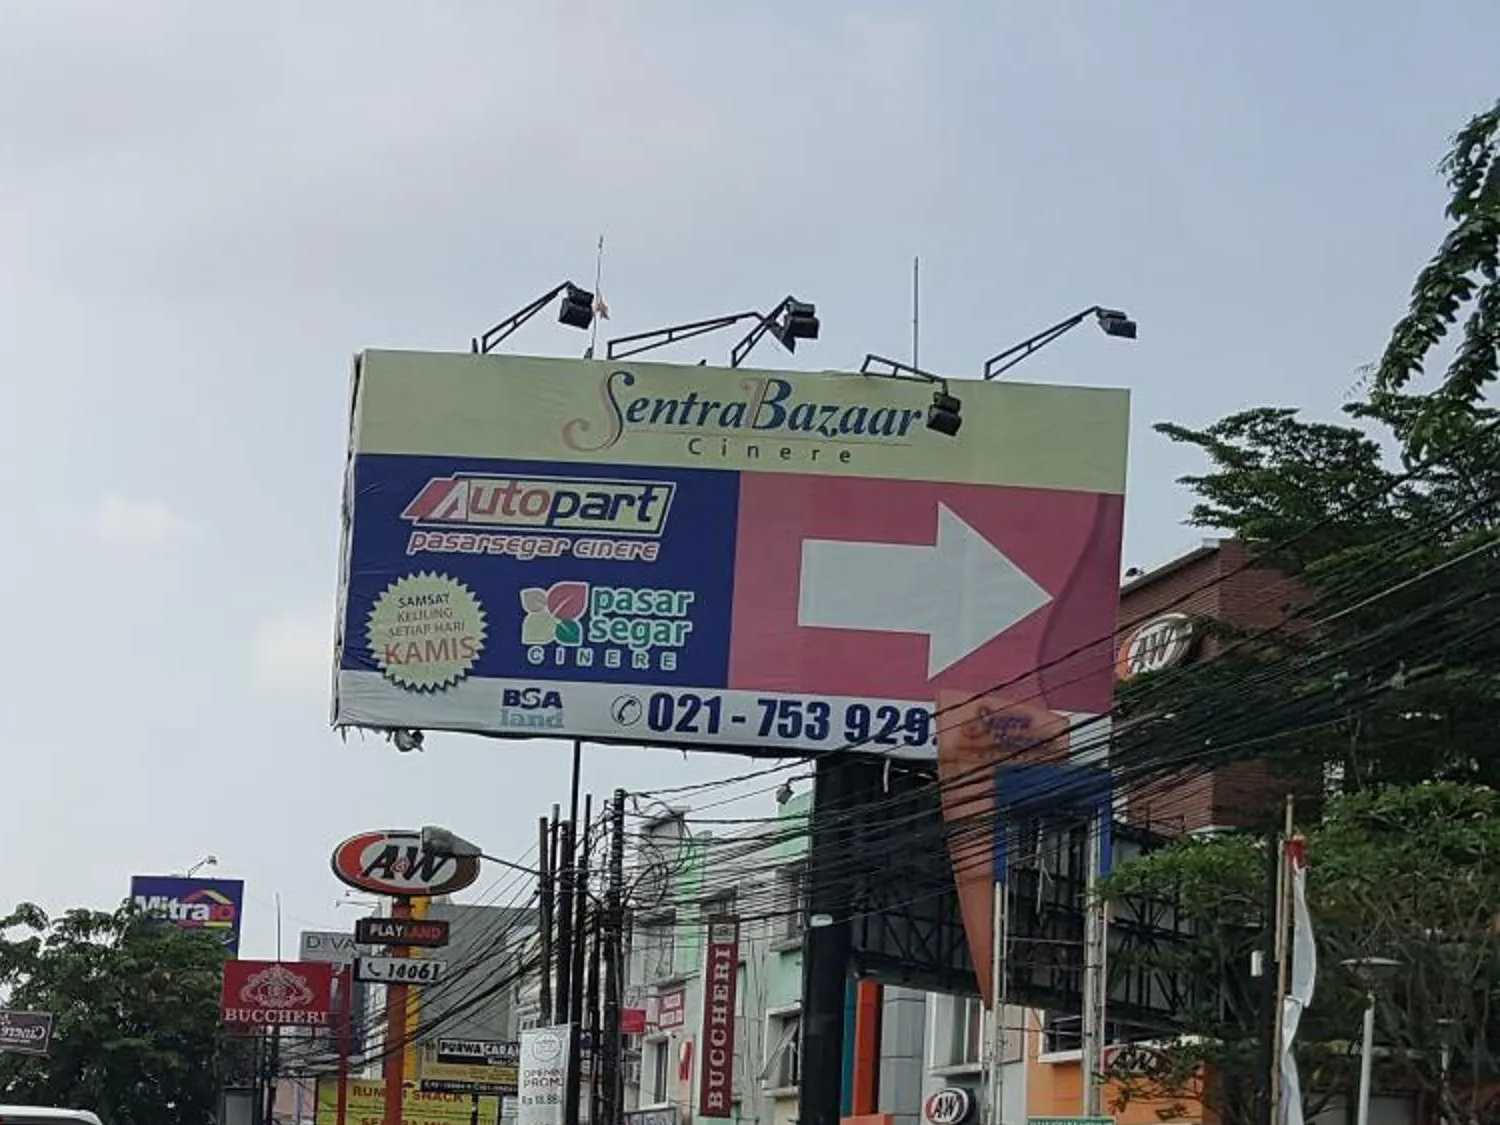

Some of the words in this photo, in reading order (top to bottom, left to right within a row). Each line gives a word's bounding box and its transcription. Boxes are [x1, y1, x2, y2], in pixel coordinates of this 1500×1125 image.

[688, 437, 852, 464] Cinere
[574, 539, 660, 561] cinere
[398, 593, 451, 609] SAMSAT
[591, 586, 695, 617] pasar
[388, 623, 431, 638] SETIAP
[434, 620, 465, 635] HARI
[589, 617, 693, 649] segar
[384, 635, 477, 666] KAMIS
[527, 646, 678, 670] CINERE
[502, 687, 563, 710] BSA
[501, 709, 565, 729] land
[647, 692, 722, 735] 021
[757, 698, 831, 741] 753
[844, 702, 937, 748] 929
[224, 1008, 327, 1024] BUCCHERI
[707, 946, 732, 1111] BUCCHERI
